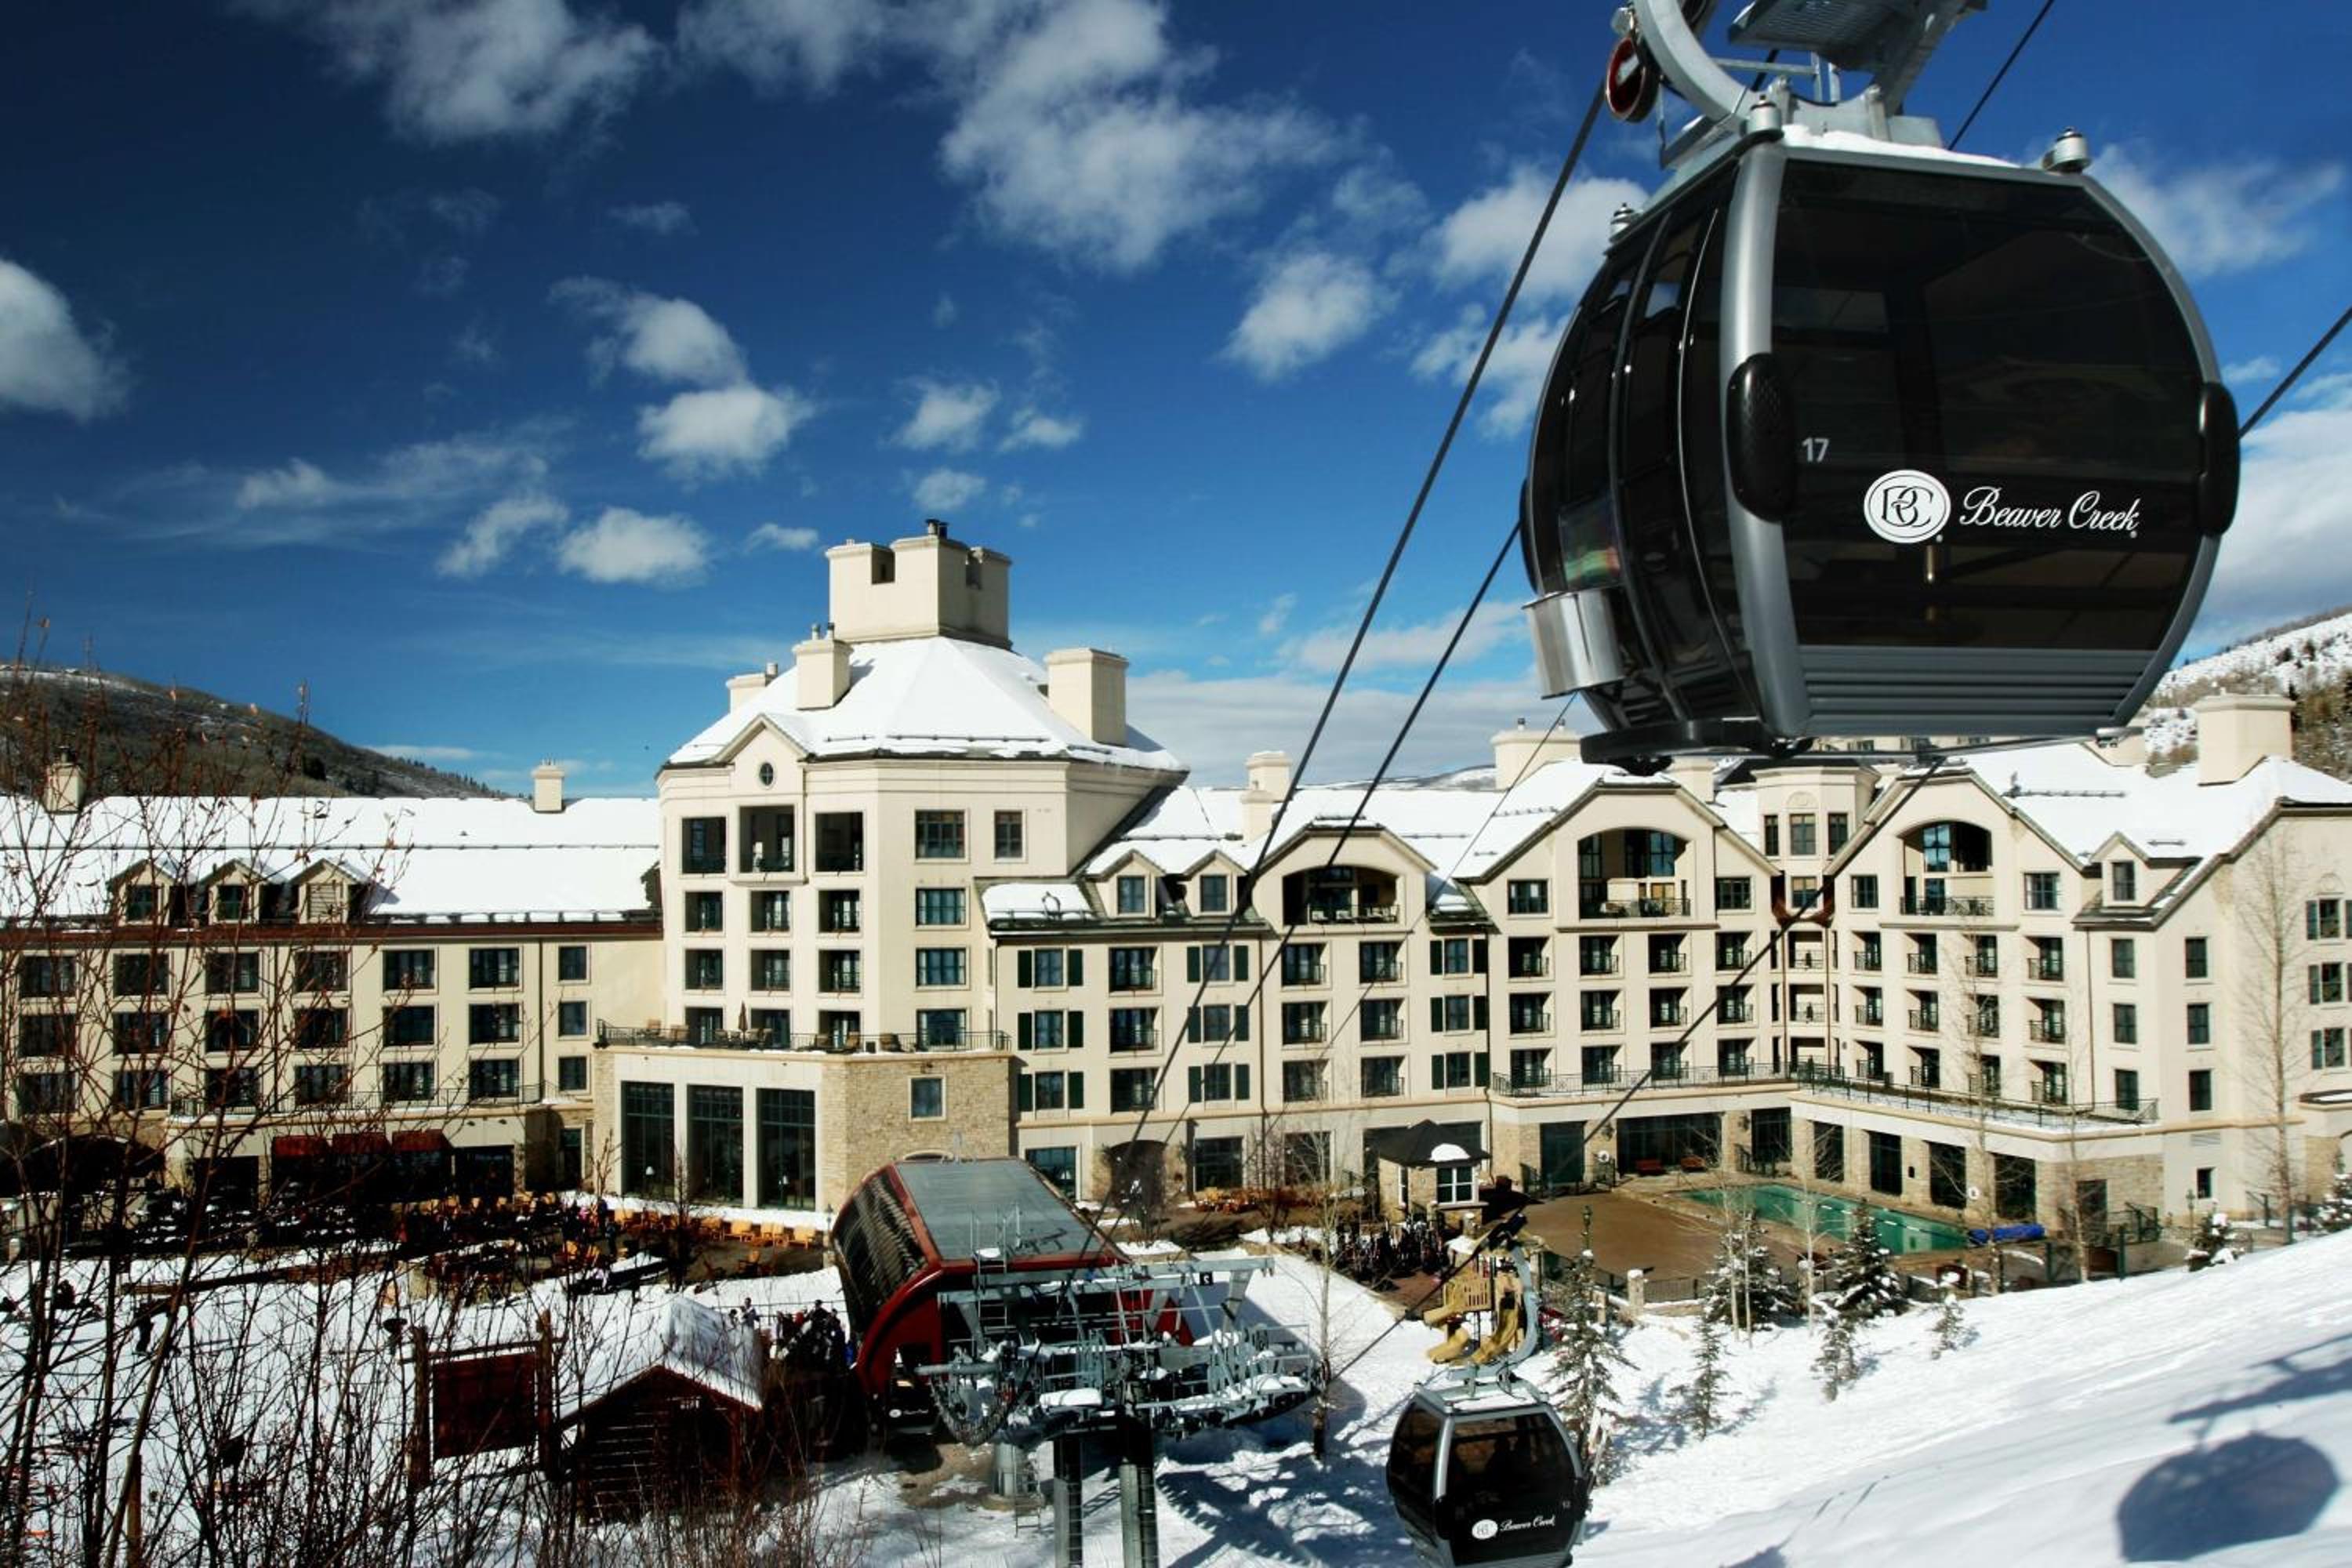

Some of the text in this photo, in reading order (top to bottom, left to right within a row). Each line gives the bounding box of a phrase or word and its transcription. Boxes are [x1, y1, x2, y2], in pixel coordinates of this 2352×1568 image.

[1802, 437, 1830, 463] 17
[1959, 485, 2141, 531] Beaver Creek
